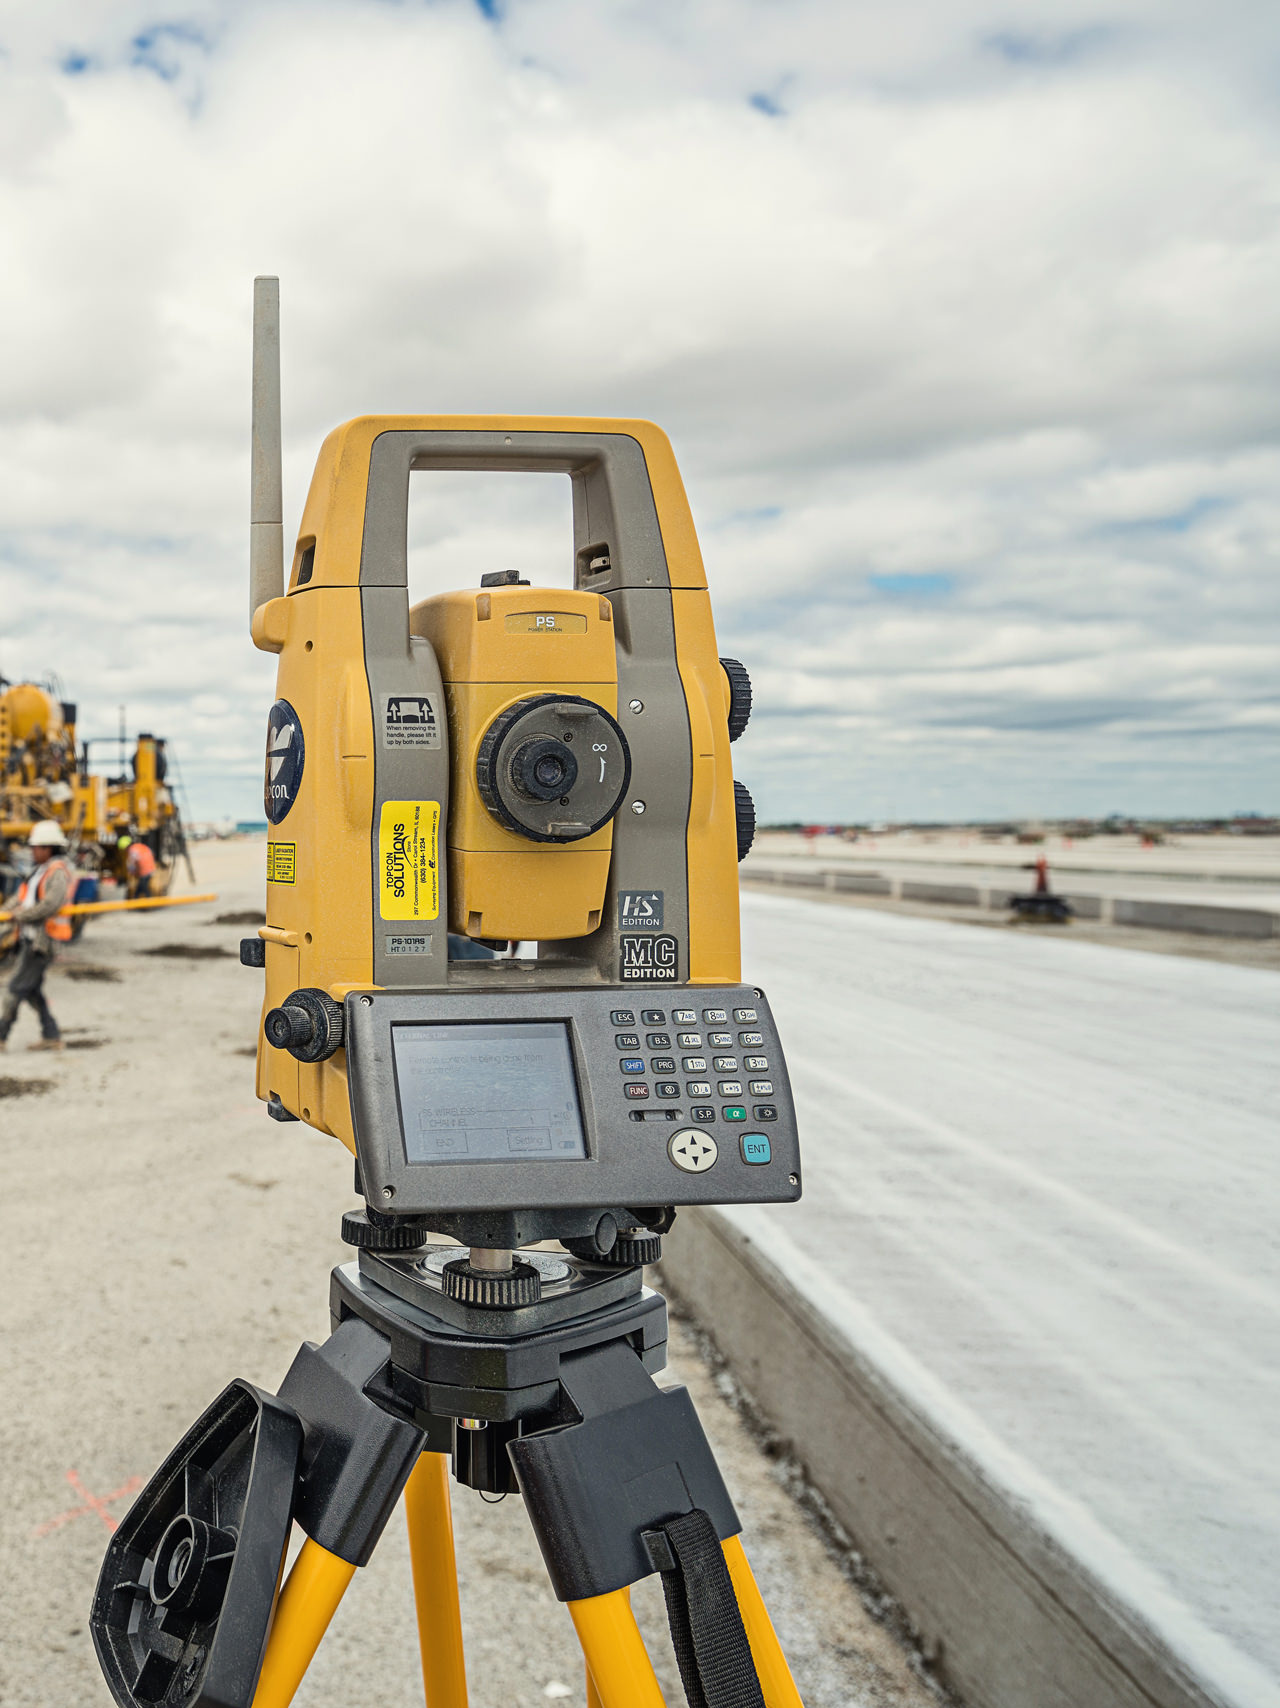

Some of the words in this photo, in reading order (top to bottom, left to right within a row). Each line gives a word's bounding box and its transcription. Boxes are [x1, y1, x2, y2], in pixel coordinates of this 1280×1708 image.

[536, 616, 555, 627] PS
[393, 823, 405, 898] SOLUTIONS
[386, 852, 394, 889] TOPCON
[622, 918, 660, 926] EDITION
[624, 938, 675, 967] MC
[623, 968, 675, 978] EDITION
[617, 1013, 633, 1021] ESC
[654, 1036, 669, 1045] B.S.
[626, 1061, 643, 1070] SHIFT
[658, 1061, 673, 1069] PRG
[629, 1087, 648, 1095] FUNC
[698, 1110, 713, 1119] S.P.
[747, 1144, 767, 1154] ENT
